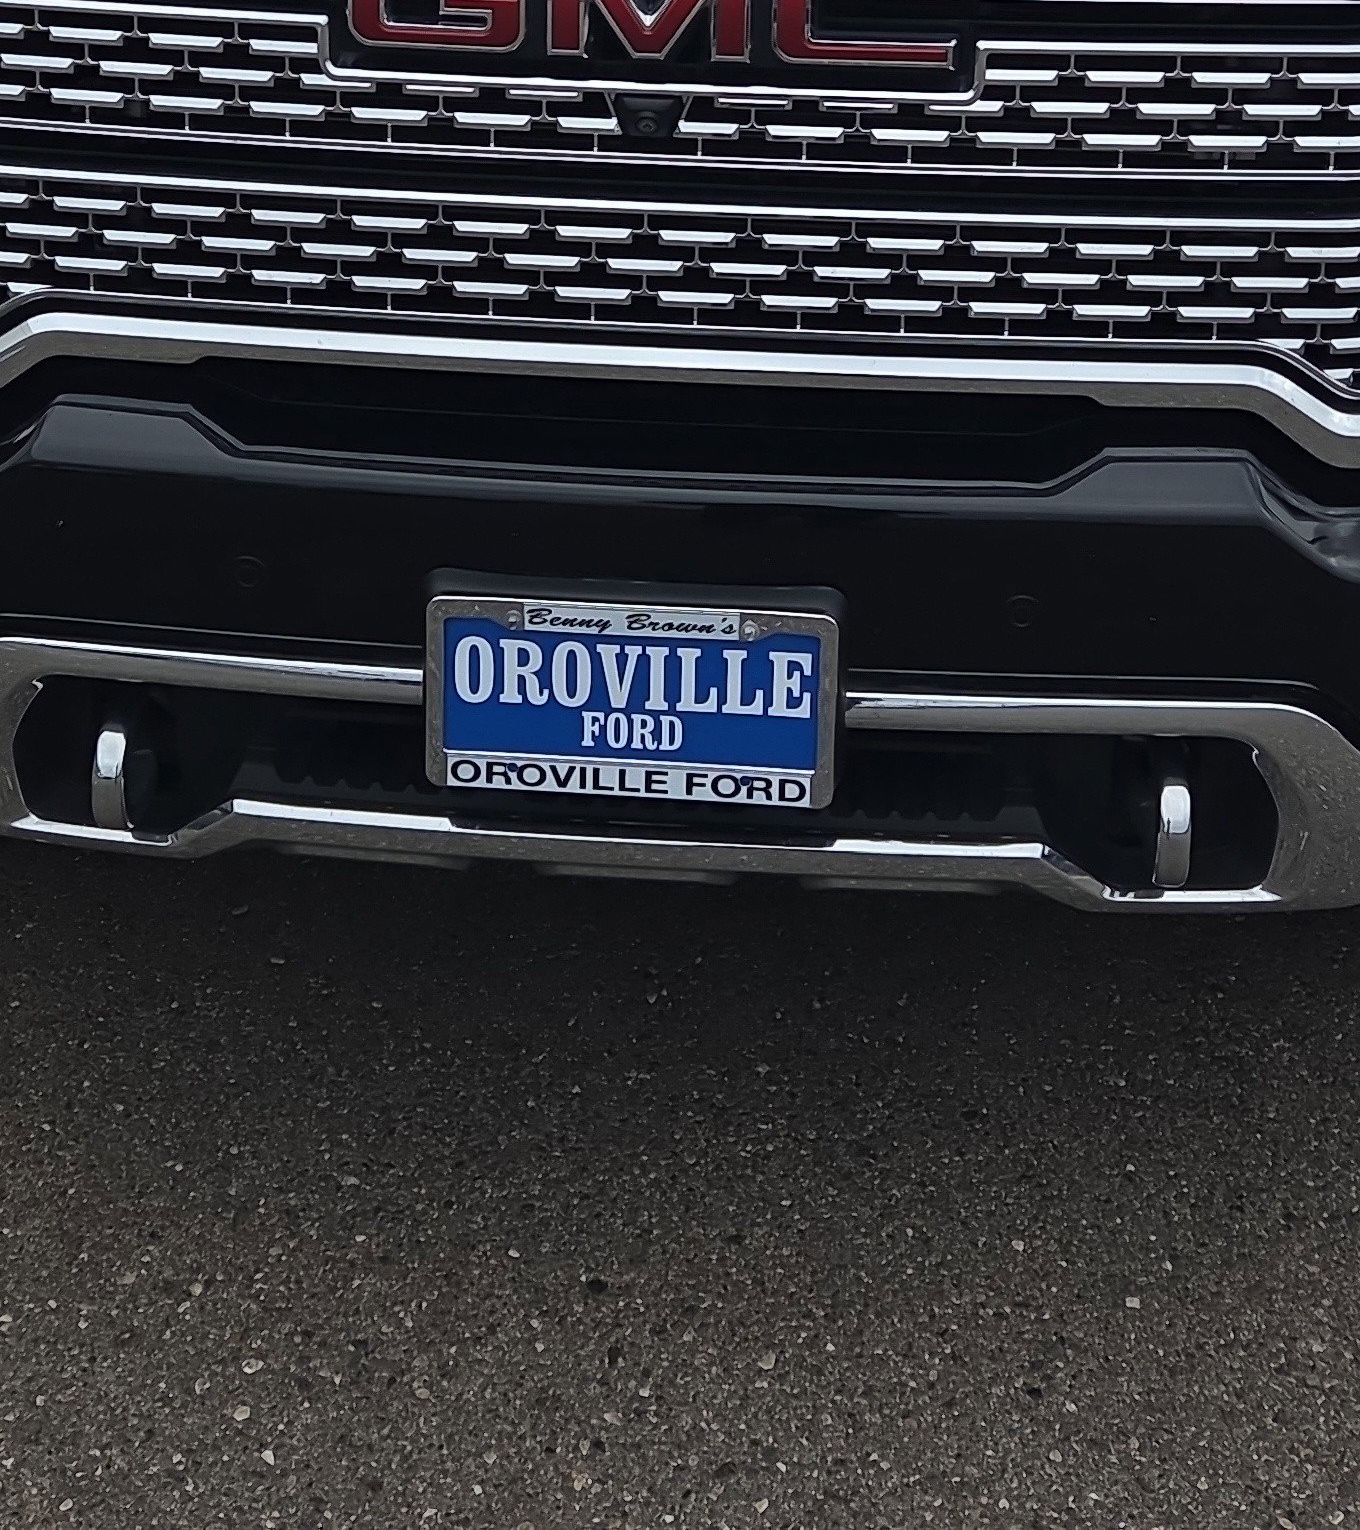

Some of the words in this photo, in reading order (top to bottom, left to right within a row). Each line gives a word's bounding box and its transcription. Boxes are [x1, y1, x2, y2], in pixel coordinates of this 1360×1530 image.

[525, 607, 613, 634] Benny
[625, 613, 738, 636] Brown's
[453, 635, 815, 720] OROVILLE
[580, 710, 684, 752] FORD
[450, 758, 669, 796] OROVILLE
[685, 773, 808, 805] FORD
